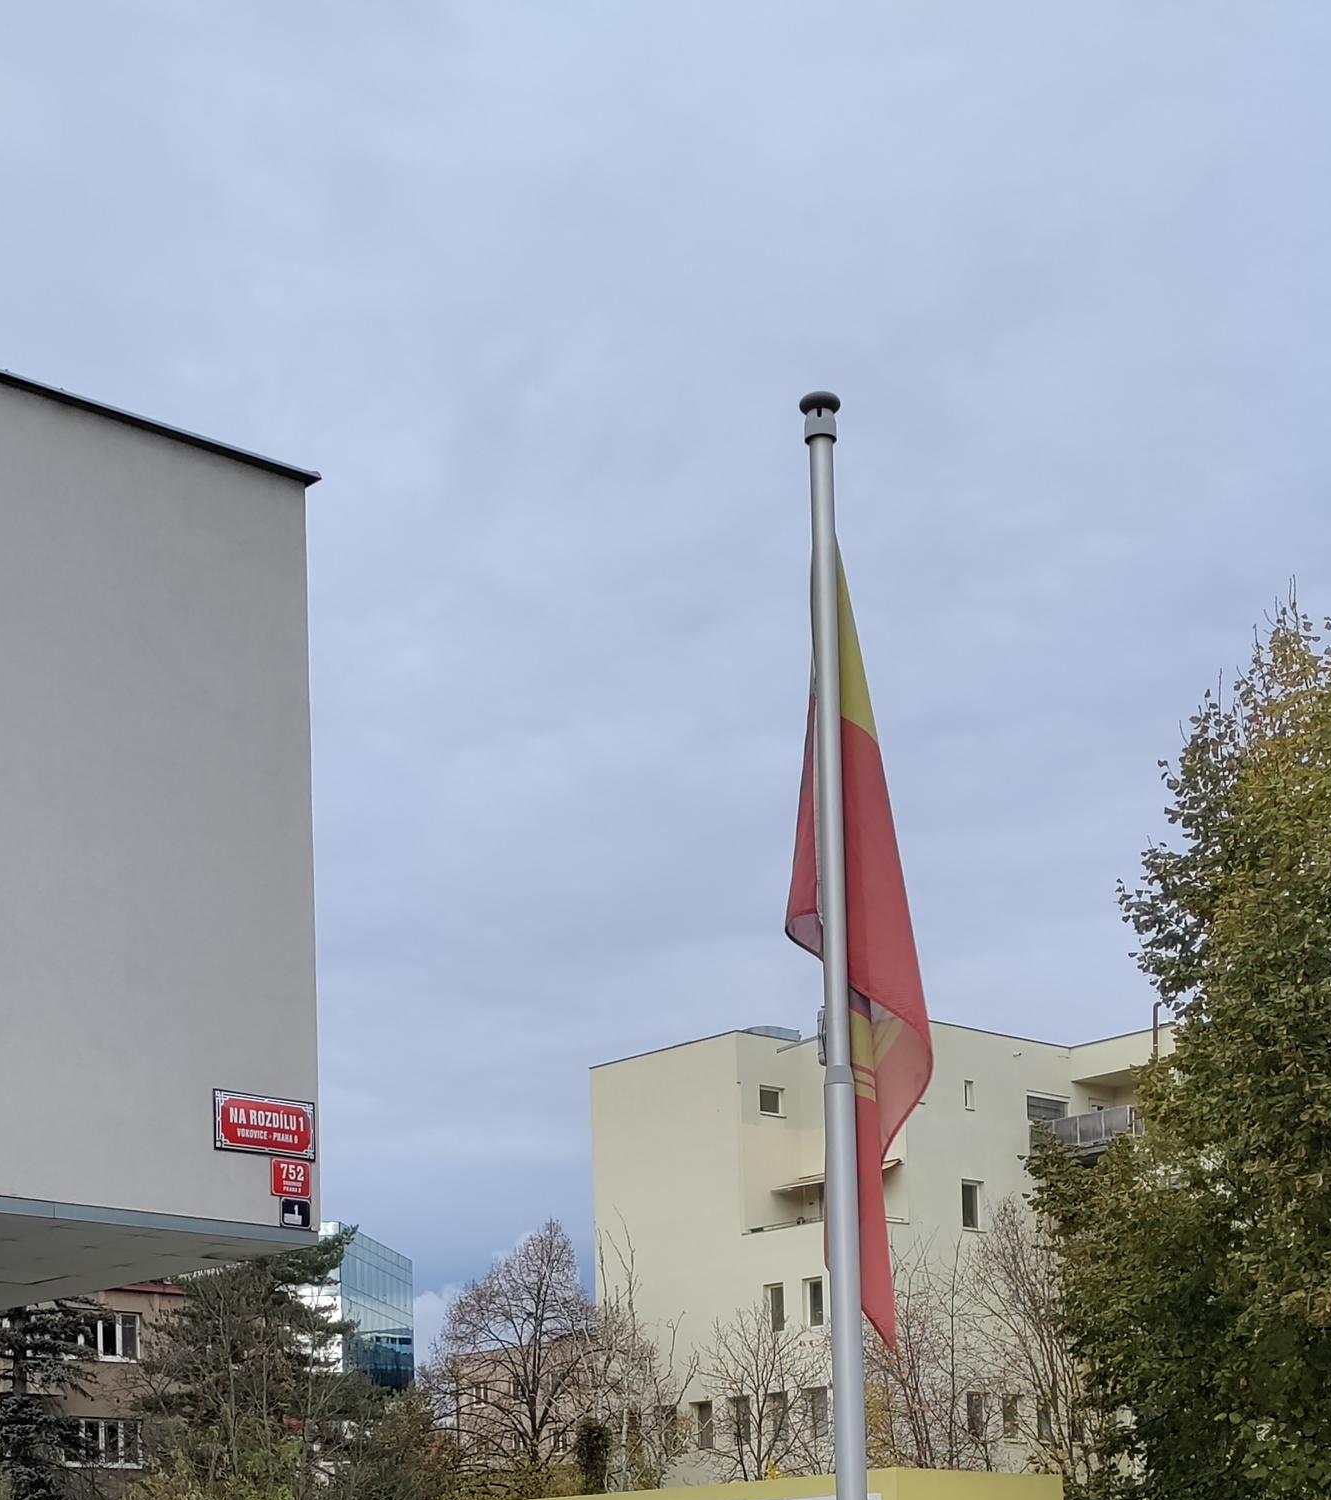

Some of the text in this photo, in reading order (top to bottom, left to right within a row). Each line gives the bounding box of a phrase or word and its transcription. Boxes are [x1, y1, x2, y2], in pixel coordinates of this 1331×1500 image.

[229, 1107, 304, 1132] NA ROZDÍLU 1
[236, 1127, 268, 1140] VOKOVICE
[280, 1163, 305, 1182] 752
